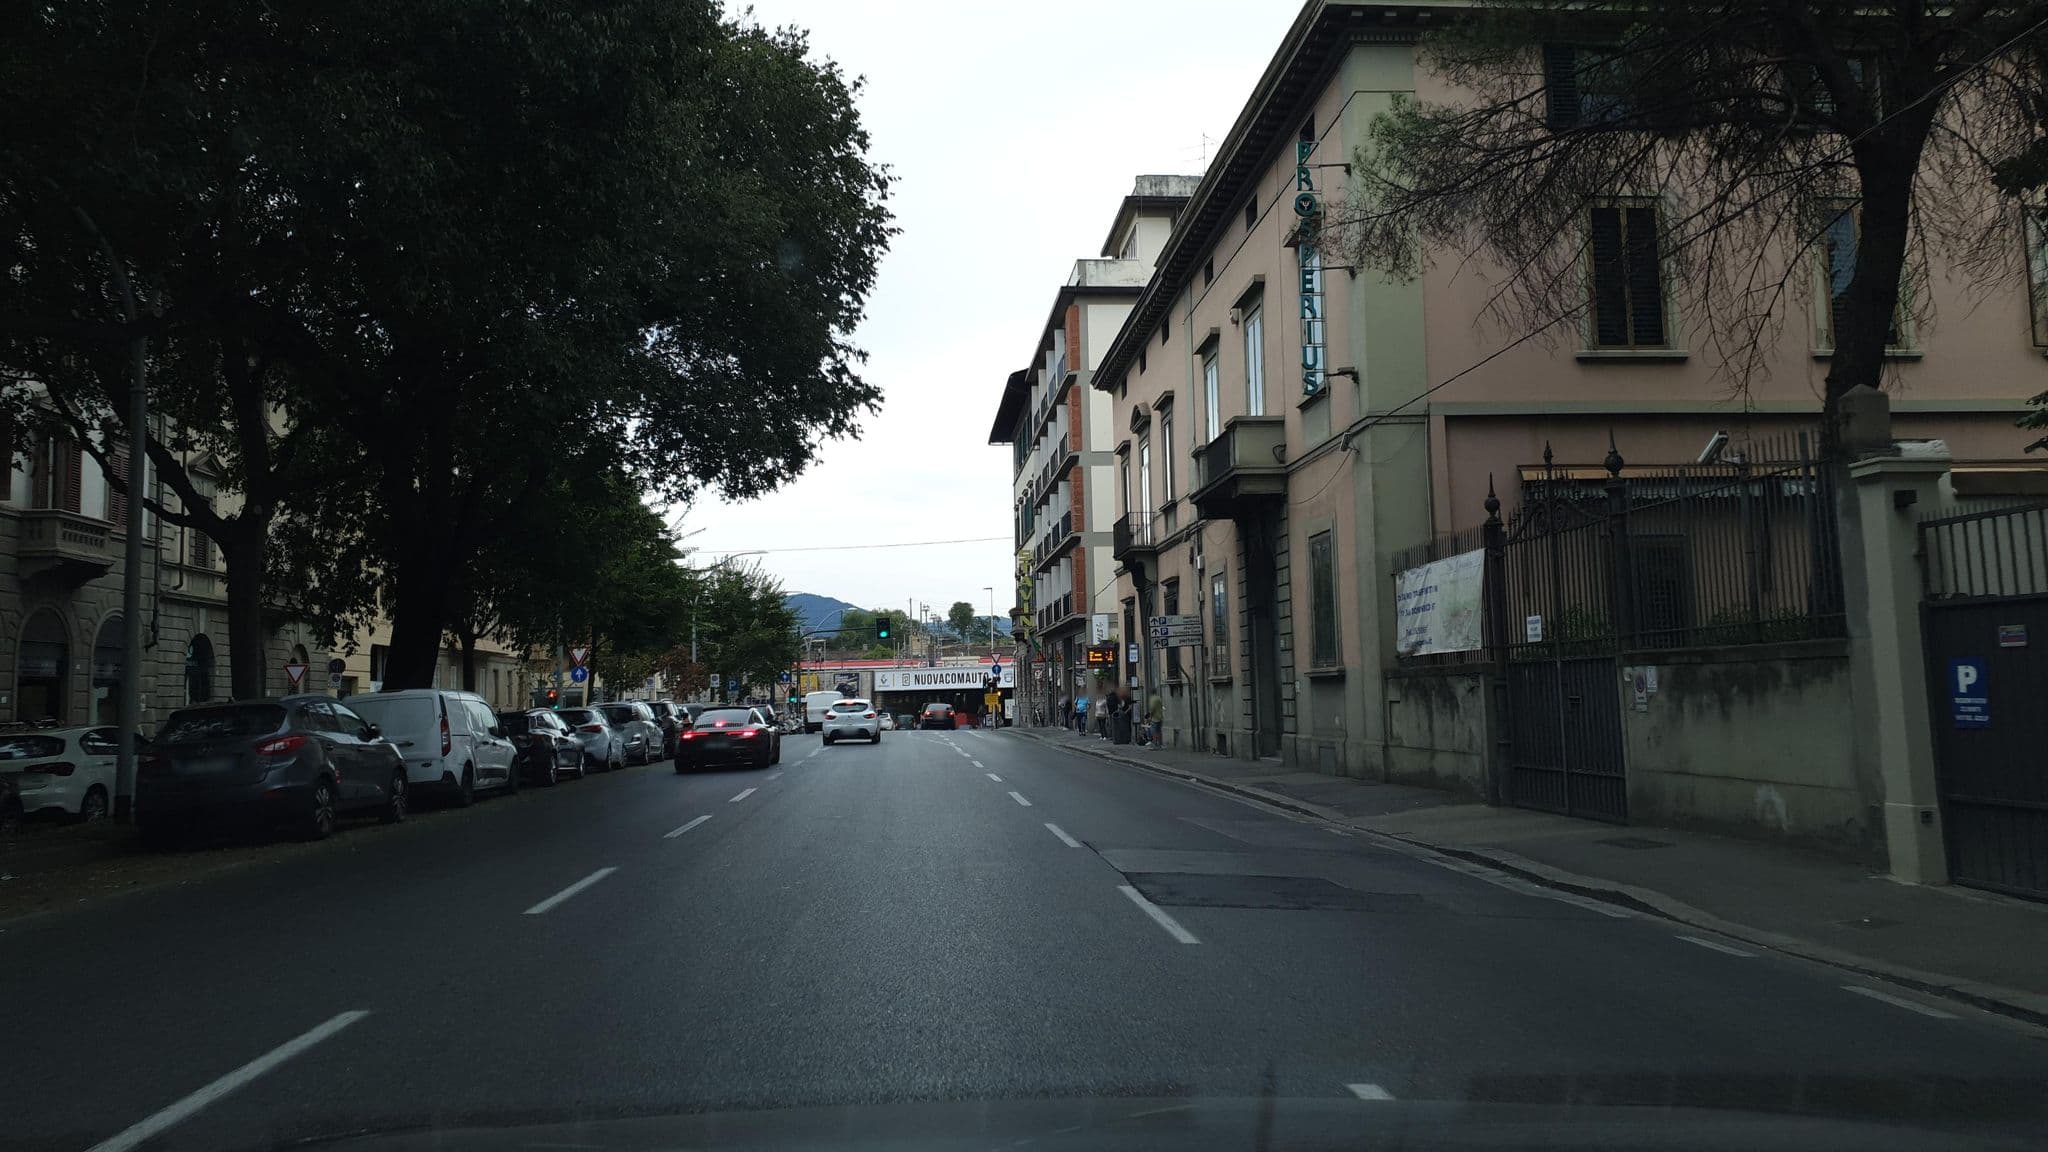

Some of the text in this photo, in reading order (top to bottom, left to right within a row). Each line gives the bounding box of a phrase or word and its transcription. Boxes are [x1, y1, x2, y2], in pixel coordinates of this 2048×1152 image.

[1294, 142, 1318, 396] PROSPERIUS
[914, 672, 989, 686] NUOVACOMAUTO
[1956, 665, 1977, 693] P
